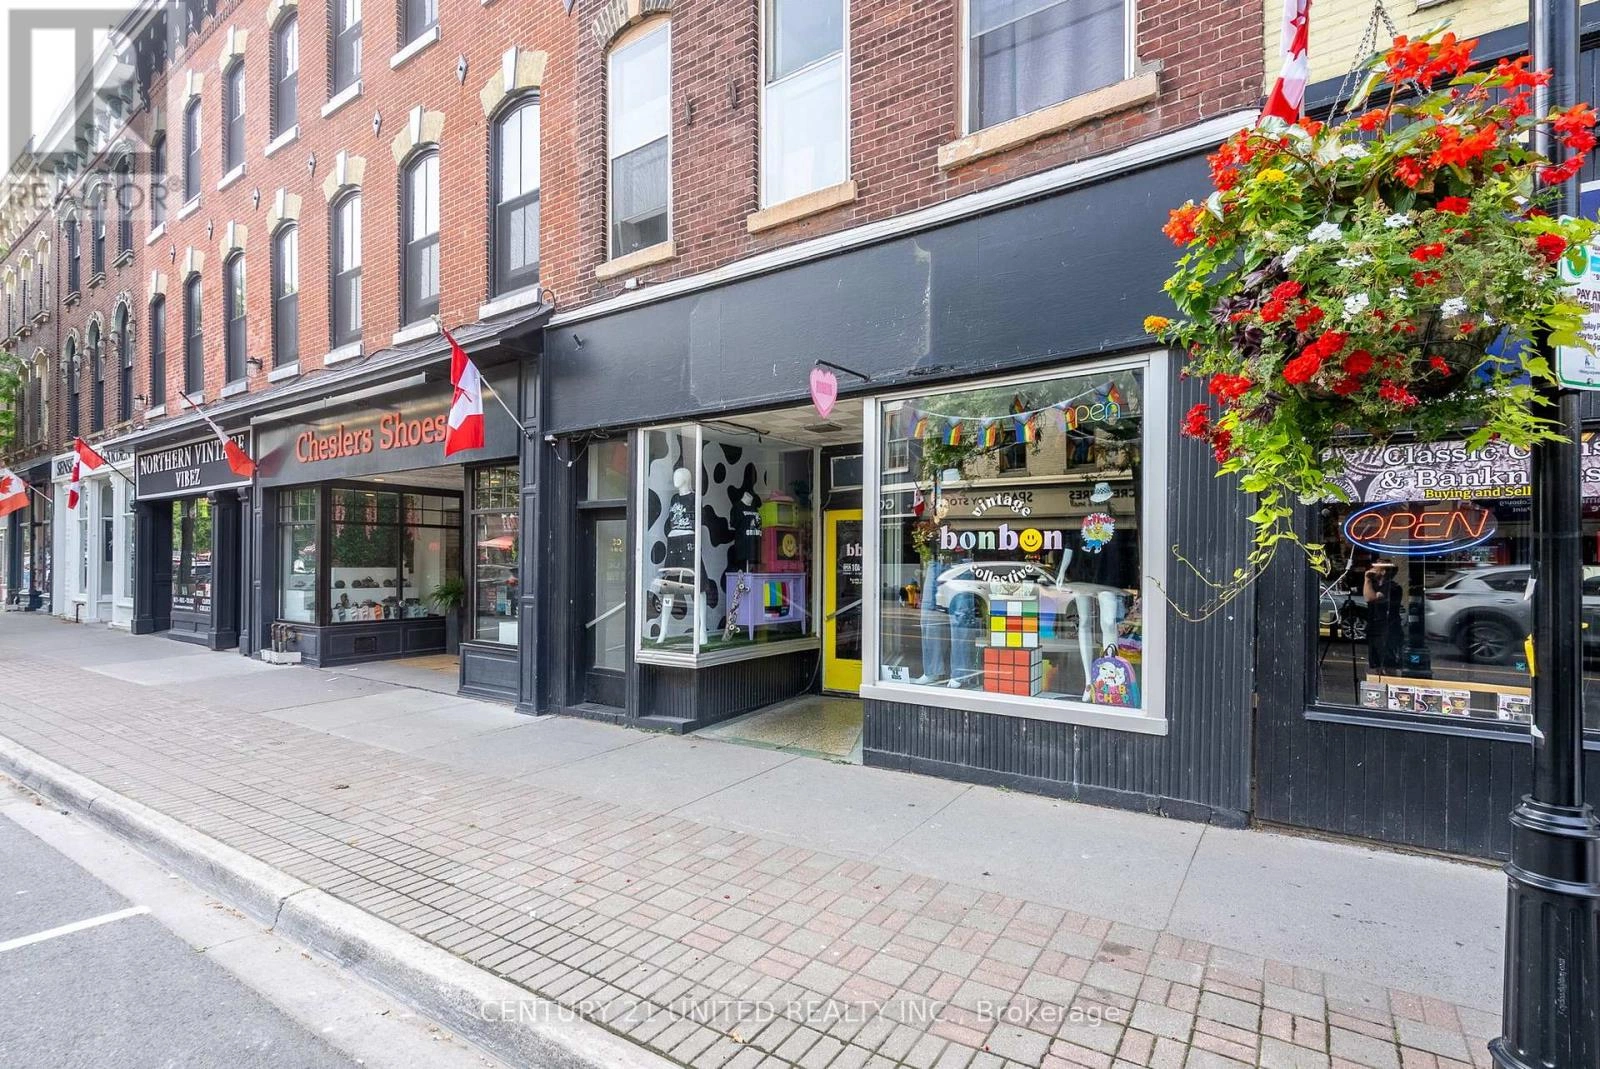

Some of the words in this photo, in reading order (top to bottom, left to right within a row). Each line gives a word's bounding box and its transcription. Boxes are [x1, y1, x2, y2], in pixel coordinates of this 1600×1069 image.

[1576, 288, 1591, 300] PAY
[296, 424, 374, 464] Cheslers
[379, 412, 448, 450] Shoes
[140, 446, 192, 476] NORTHERN
[194, 434, 246, 465] VINTAE
[1383, 445, 1498, 466] Classic
[175, 468, 201, 488] VIBEZ
[1380, 469, 1405, 489] &
[1424, 489, 1472, 500] Buying
[1474, 487, 1501, 498] and
[1504, 485, 1533, 497] Sell
[971, 493, 1032, 518] vintage
[1350, 509, 1489, 540] OPEN
[969, 563, 1034, 585] collective
